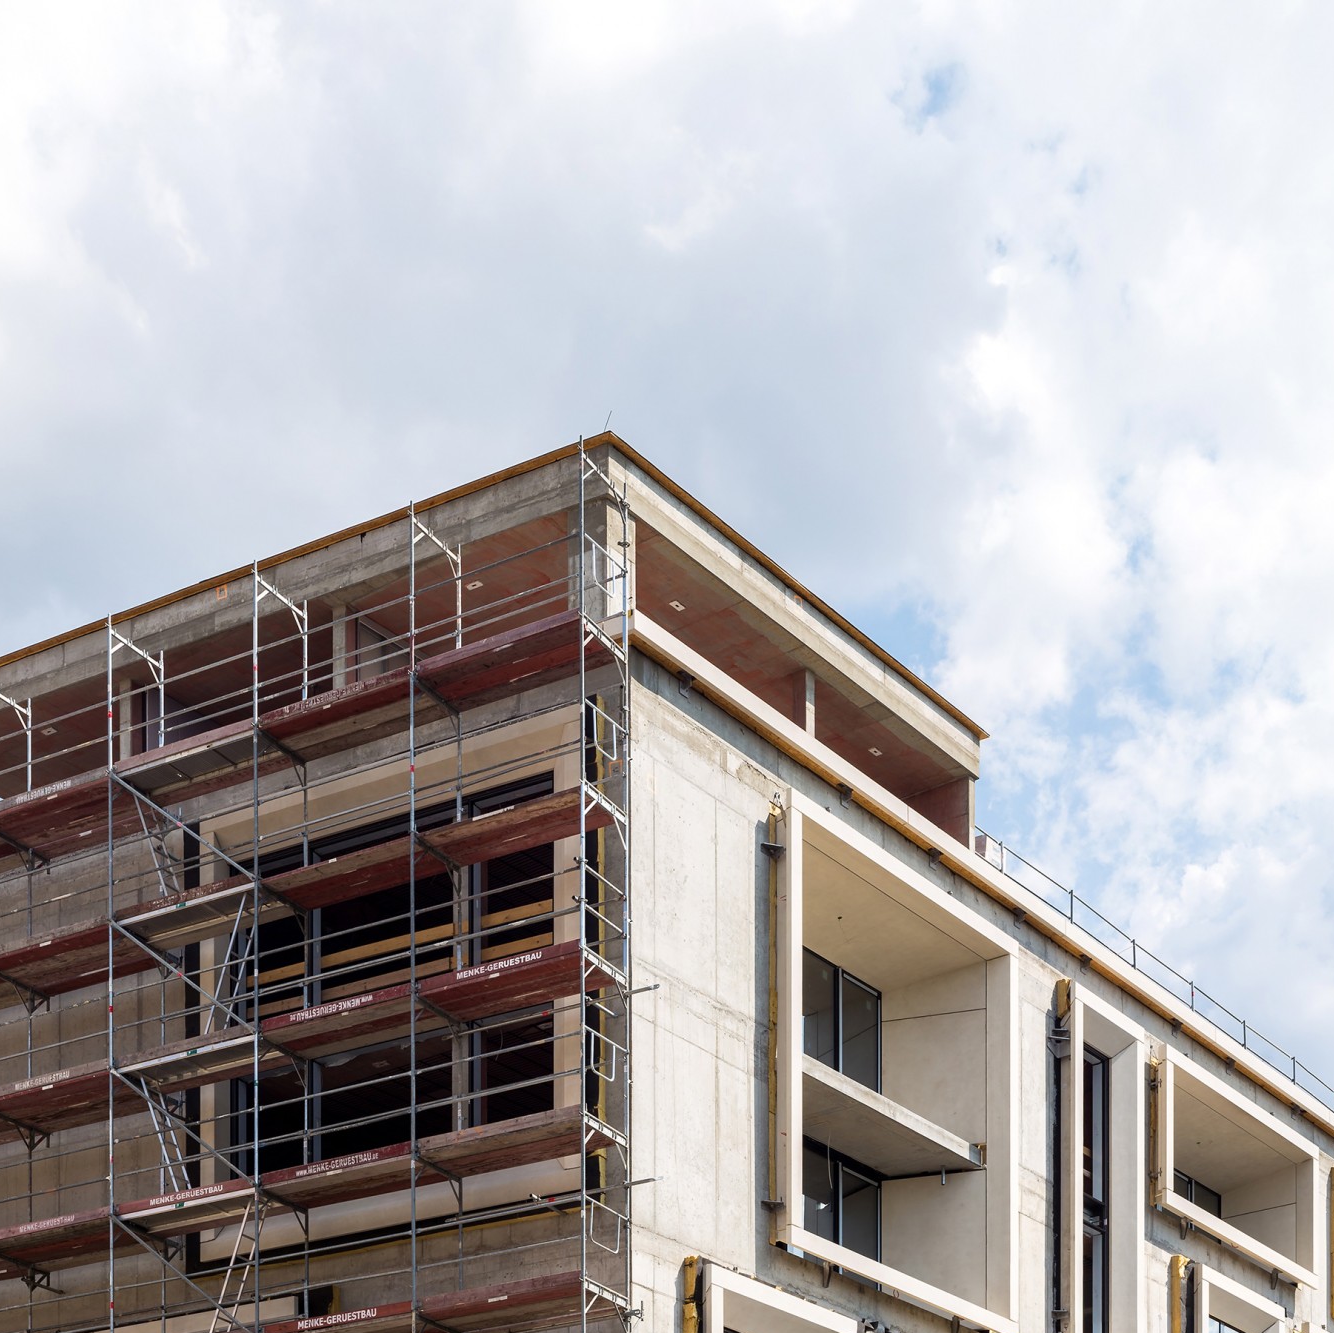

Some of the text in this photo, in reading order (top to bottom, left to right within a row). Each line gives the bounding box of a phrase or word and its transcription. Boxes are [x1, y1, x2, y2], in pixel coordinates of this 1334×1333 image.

[17, 778, 72, 805] MENKE-GERUESTBAU
[456, 951, 543, 980] MENKE-GERUESTBAU
[15, 1069, 70, 1090] MENKE-GERUESTBAU
[149, 1185, 223, 1206] MENKE-GERUESTBAU
[19, 1214, 75, 1232] MENKE-GERUESTBAU
[297, 1308, 377, 1330] MENKE-GERUESTBAU
